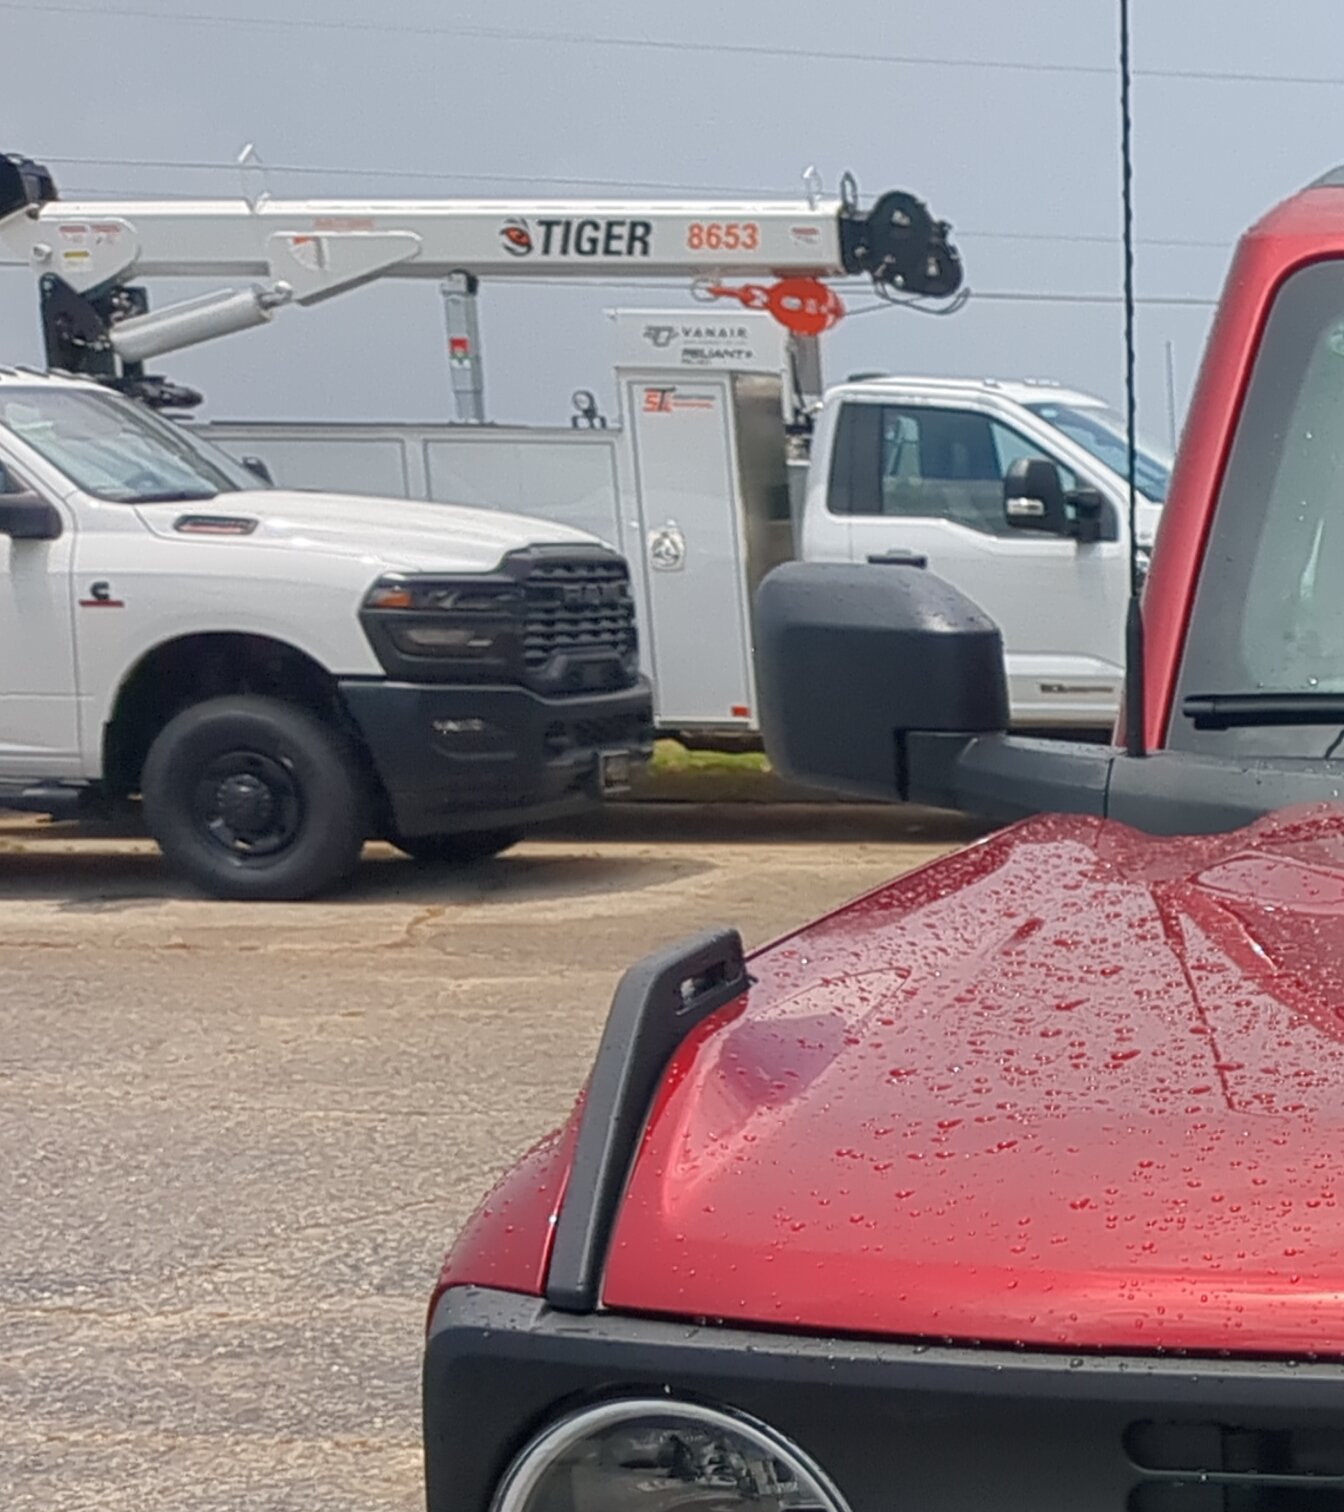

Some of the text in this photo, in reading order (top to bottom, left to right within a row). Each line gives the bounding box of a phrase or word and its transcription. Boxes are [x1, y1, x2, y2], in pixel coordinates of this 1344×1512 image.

[537, 220, 652, 256] TIGER
[686, 223, 759, 250] 8653
[681, 326, 748, 339] VANAIR
